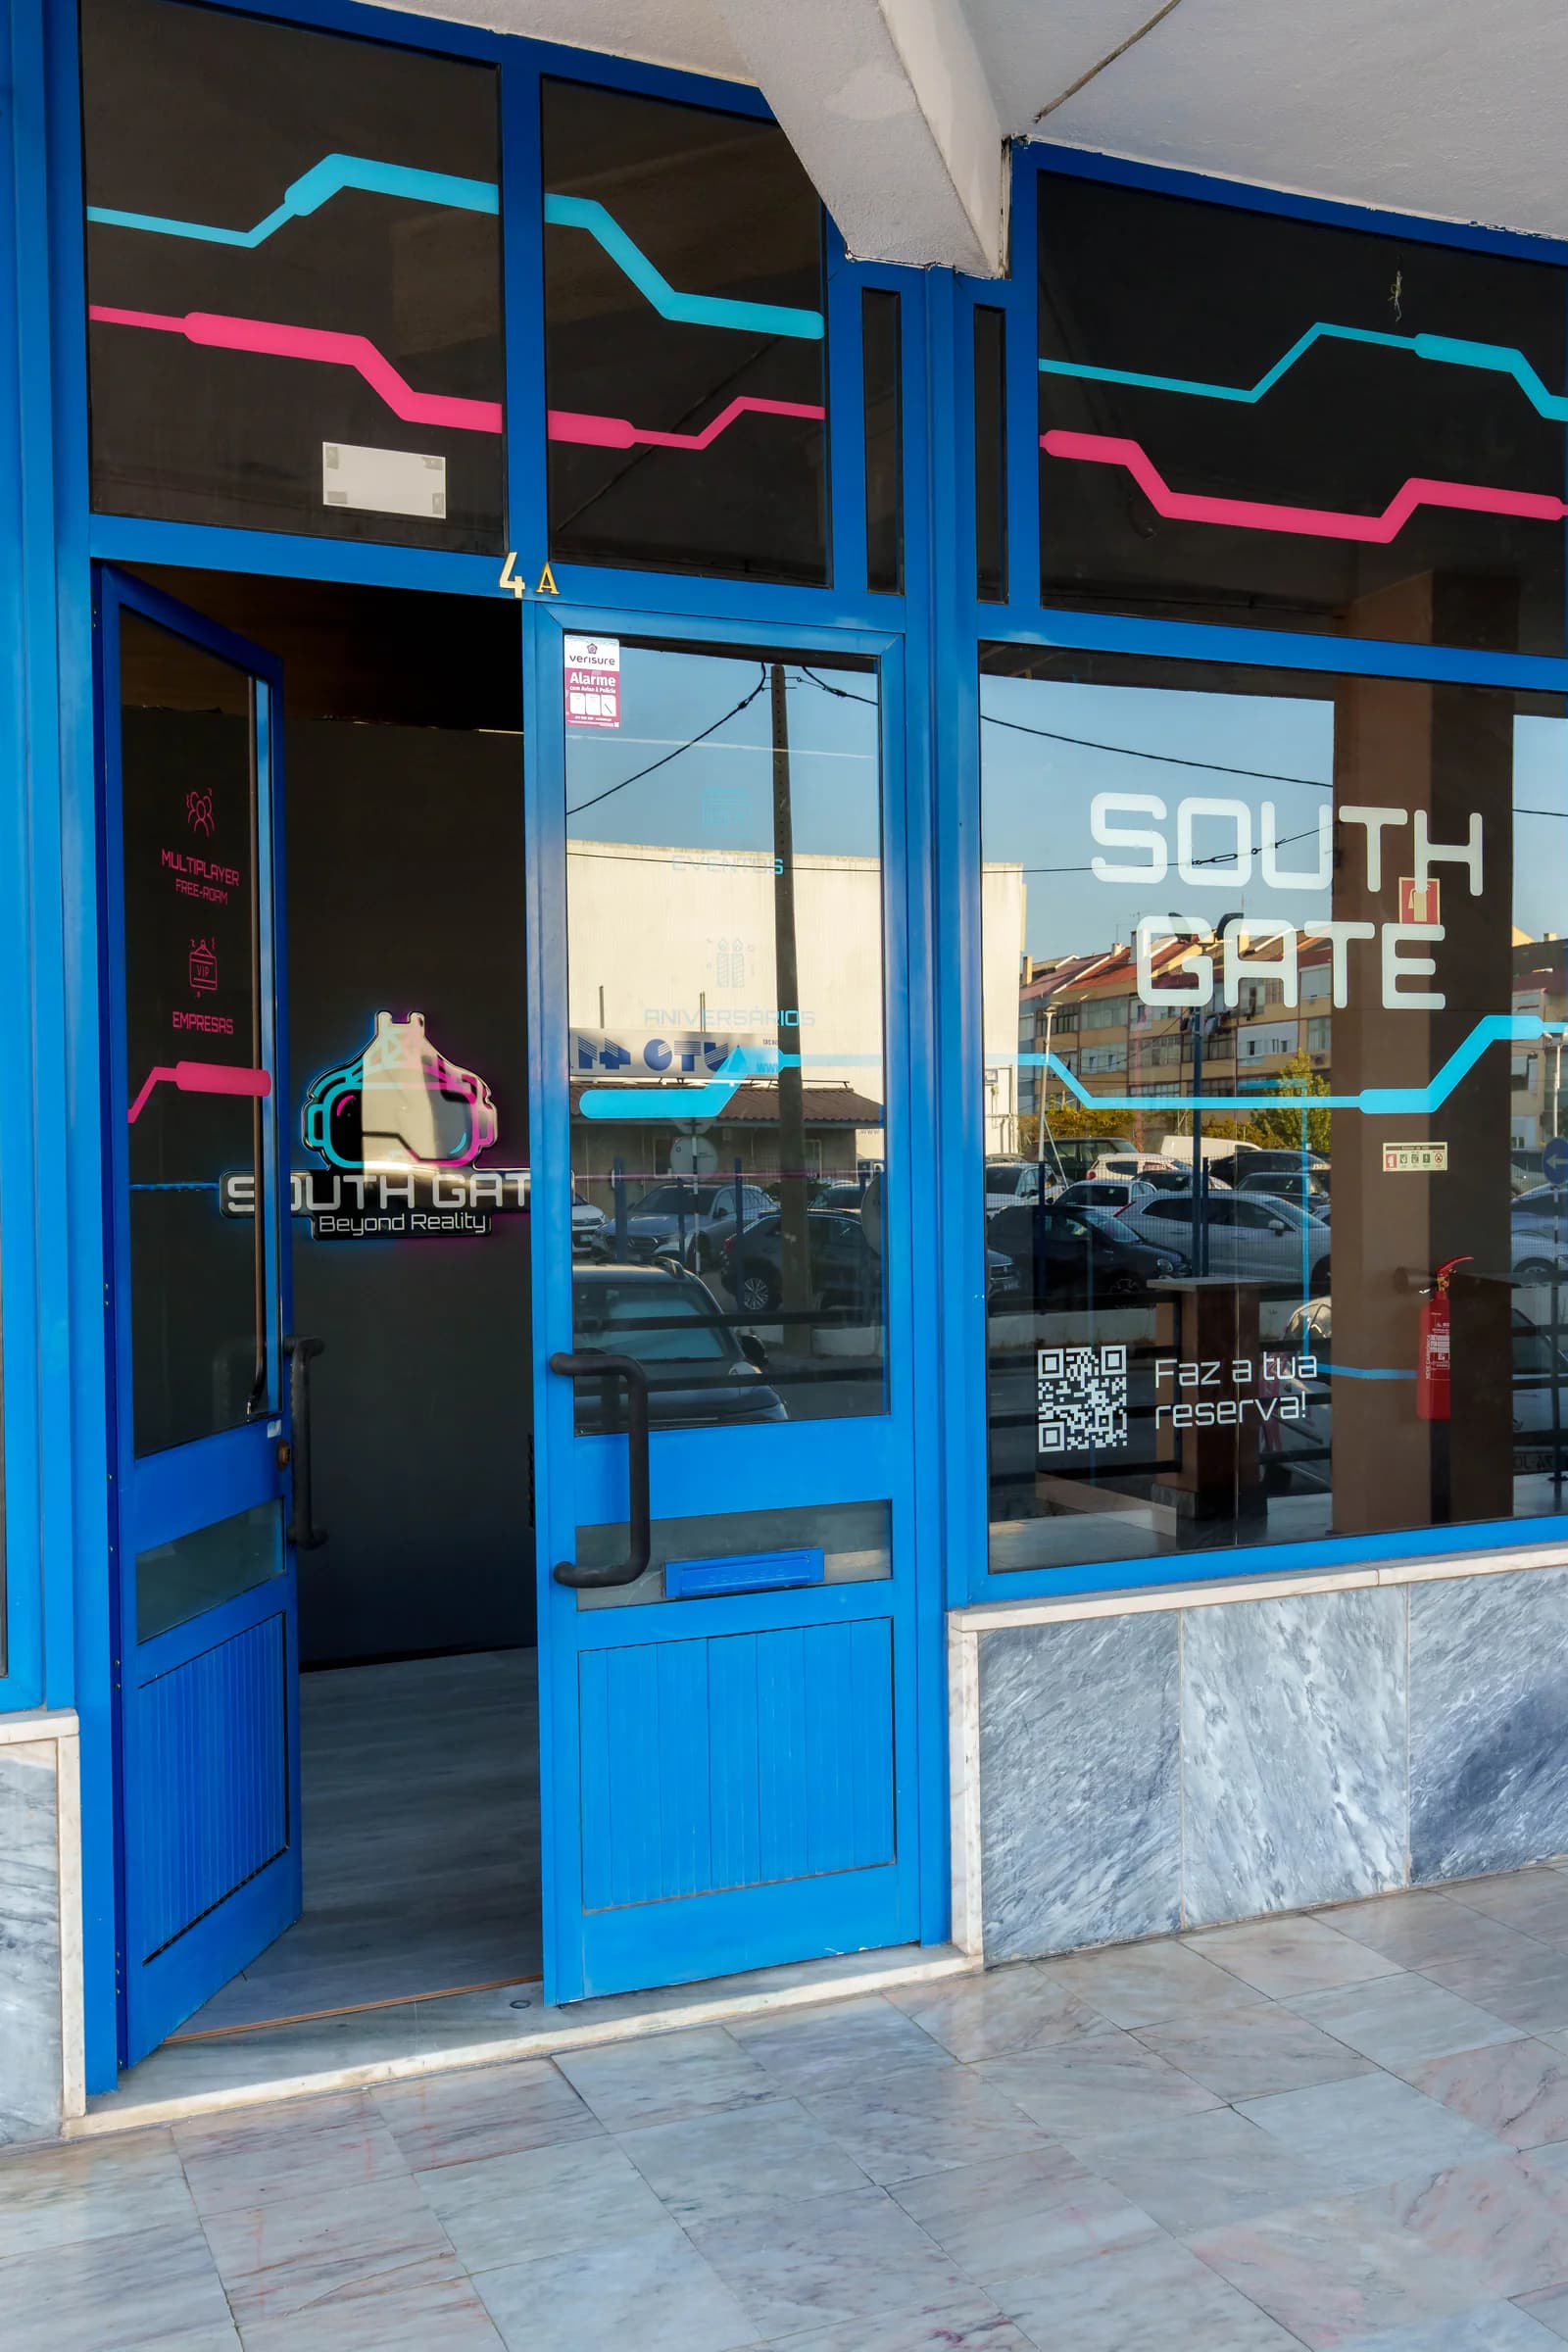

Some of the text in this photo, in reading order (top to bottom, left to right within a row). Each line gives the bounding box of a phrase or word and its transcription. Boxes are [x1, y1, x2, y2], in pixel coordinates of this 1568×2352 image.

[499, 552, 561, 599] 4 A
[569, 655, 615, 665] verisure
[569, 671, 615, 686] Alarme
[1090, 792, 1484, 897] SOUTH
[161, 848, 240, 886] MULTIPLAYER
[672, 855, 784, 875] EVENTOS
[175, 878, 228, 906] FREE-ROAM
[196, 964, 211, 977] VIP
[1136, 915, 1446, 1010] GATE
[172, 1010, 234, 1035] EMPRESAS
[644, 1005, 815, 1027] ANIVERSÁRIOS
[227, 1172, 531, 1212] SUTH GAT
[318, 1212, 486, 1236] Beyond Reality
[1154, 1350, 1318, 1389] Faz a tua
[1154, 1391, 1306, 1430] reserva!
